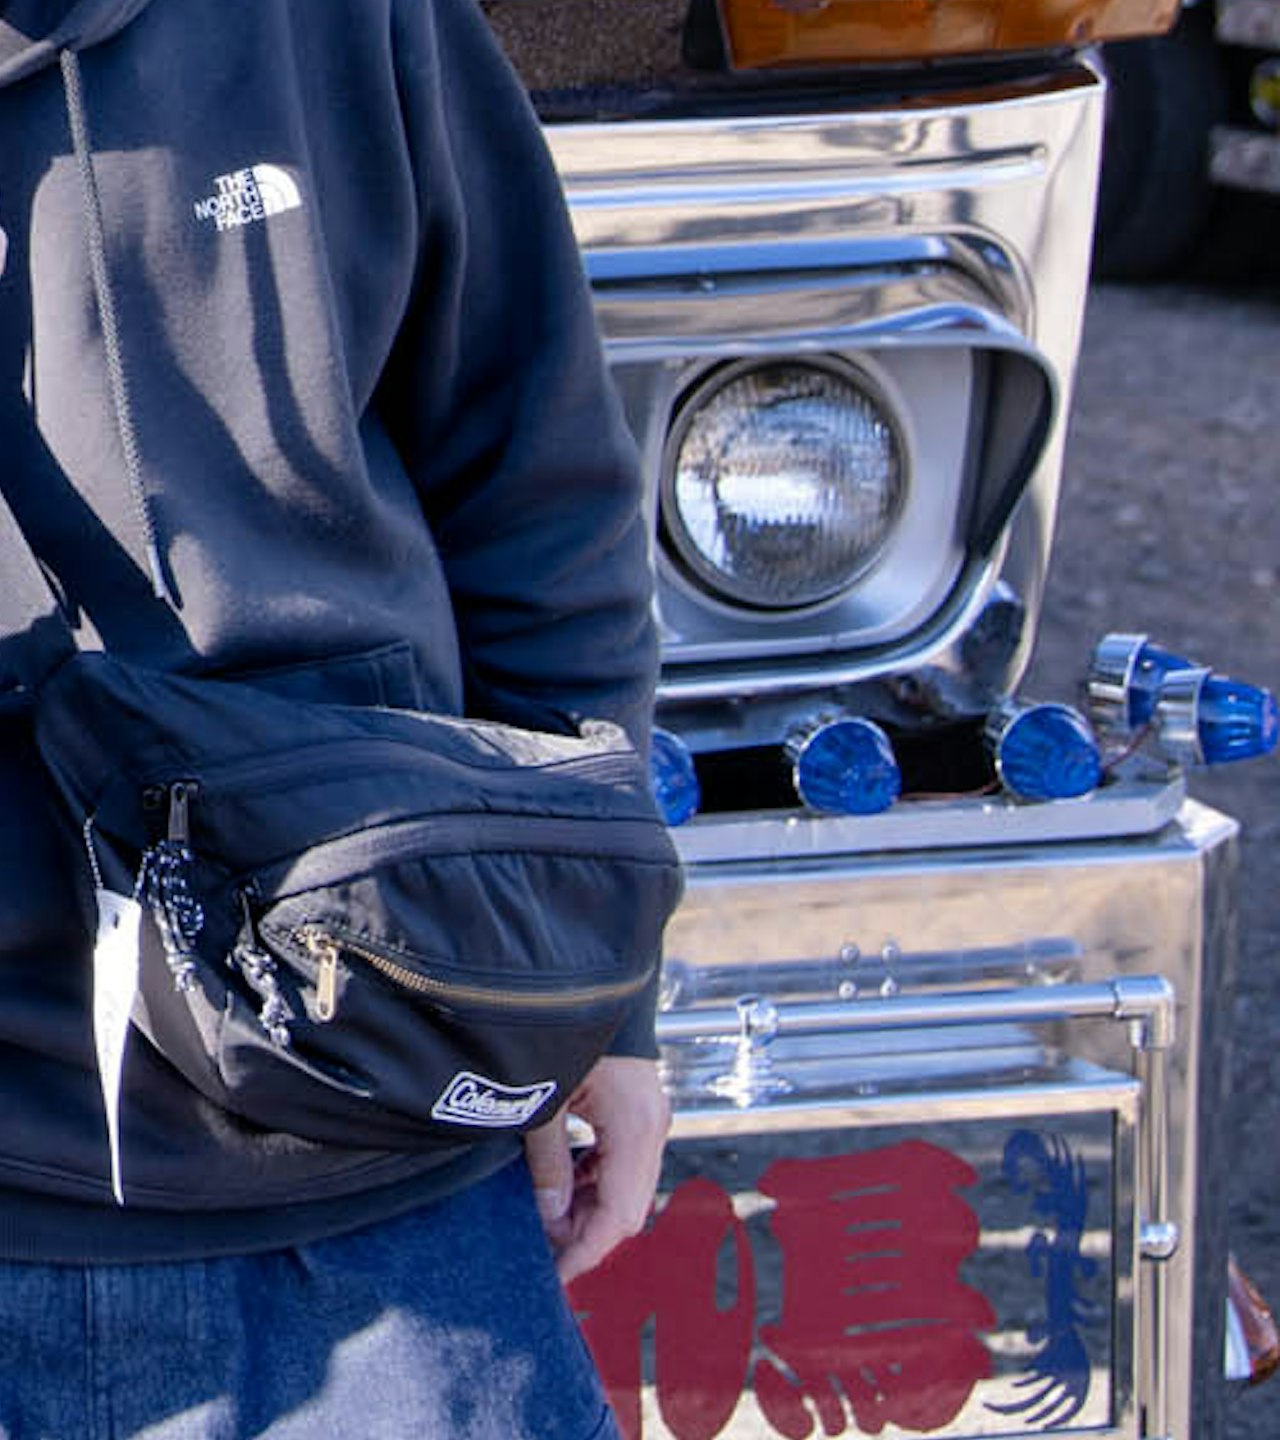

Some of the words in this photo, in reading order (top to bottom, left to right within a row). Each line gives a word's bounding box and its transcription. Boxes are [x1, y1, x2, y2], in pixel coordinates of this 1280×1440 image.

[214, 167, 254, 194] THE
[193, 181, 260, 221] NORTH
[214, 201, 266, 232] FACE
